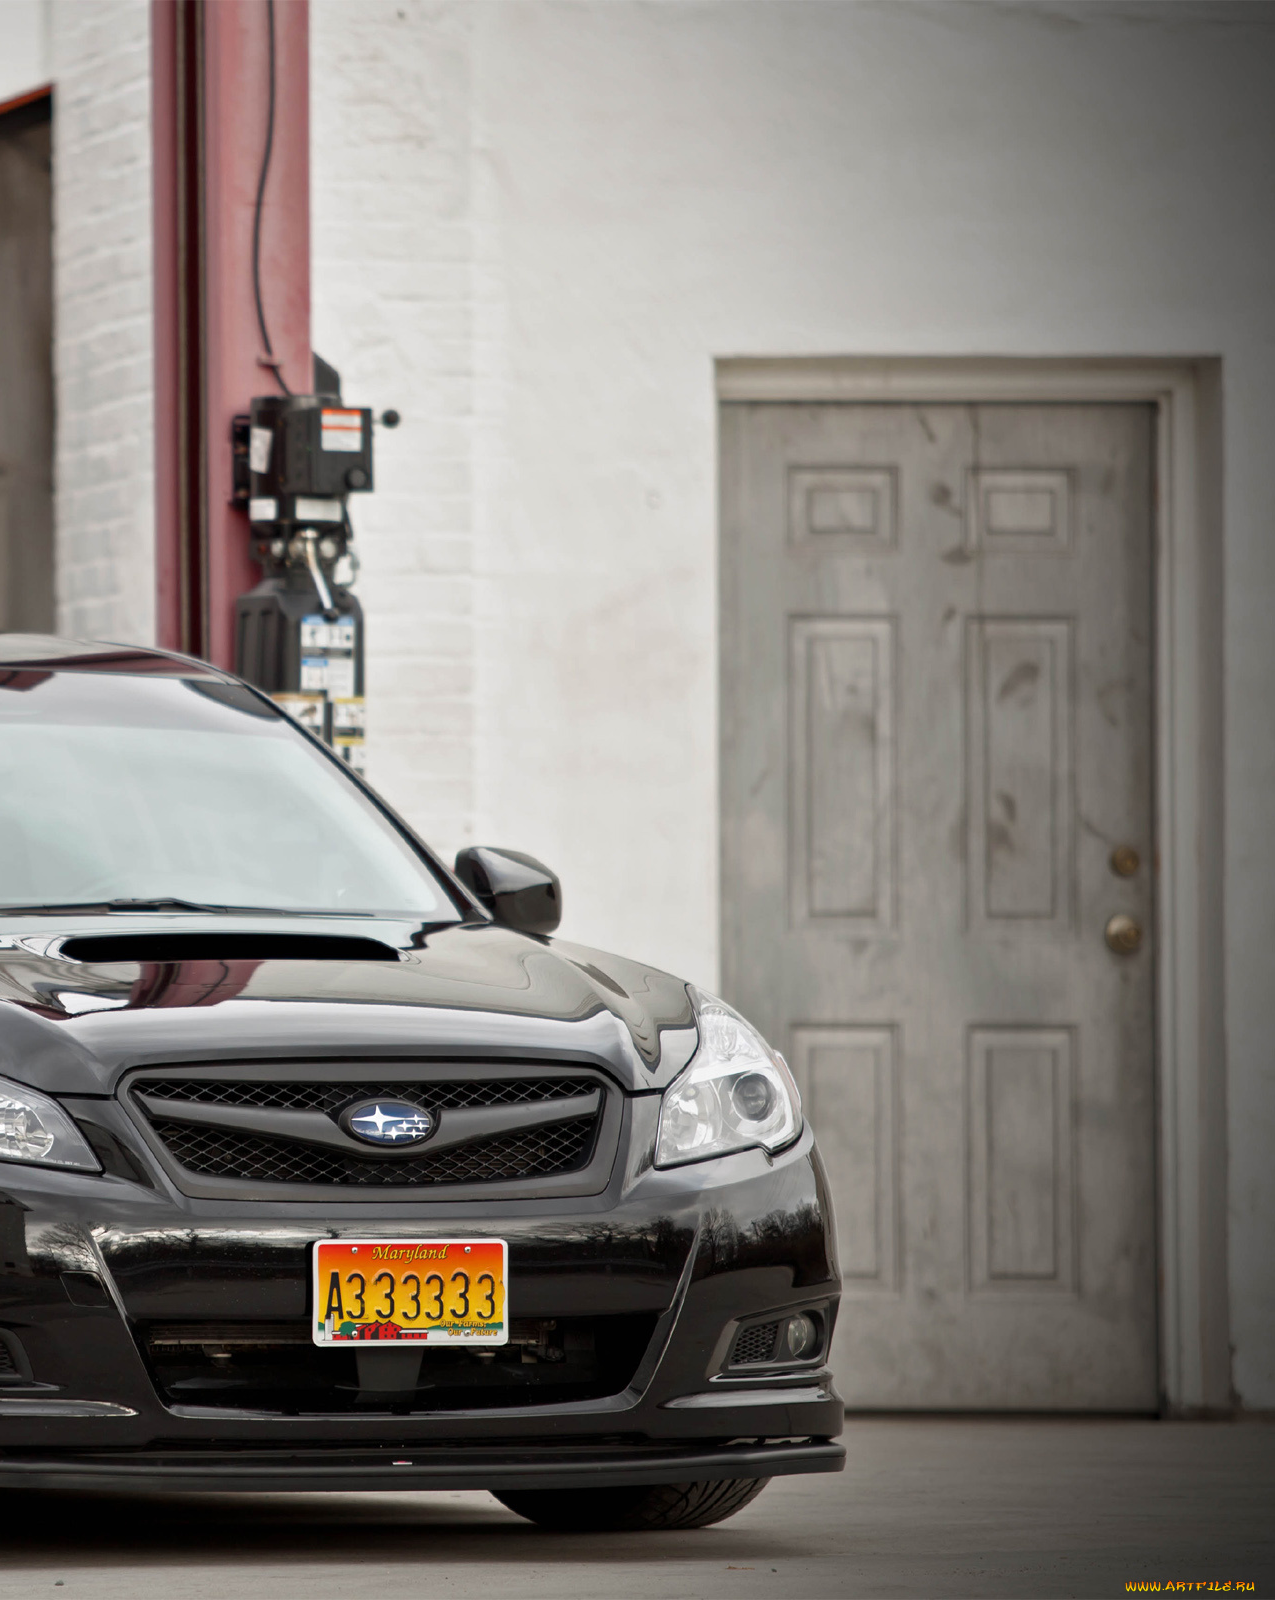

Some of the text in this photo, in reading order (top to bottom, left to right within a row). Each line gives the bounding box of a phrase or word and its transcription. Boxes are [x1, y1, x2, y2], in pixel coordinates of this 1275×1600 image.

[371, 1244, 450, 1264] Maryland
[324, 1271, 496, 1320] A333333
[439, 1320, 456, 1328] Our
[447, 1328, 498, 1337] Our Future
